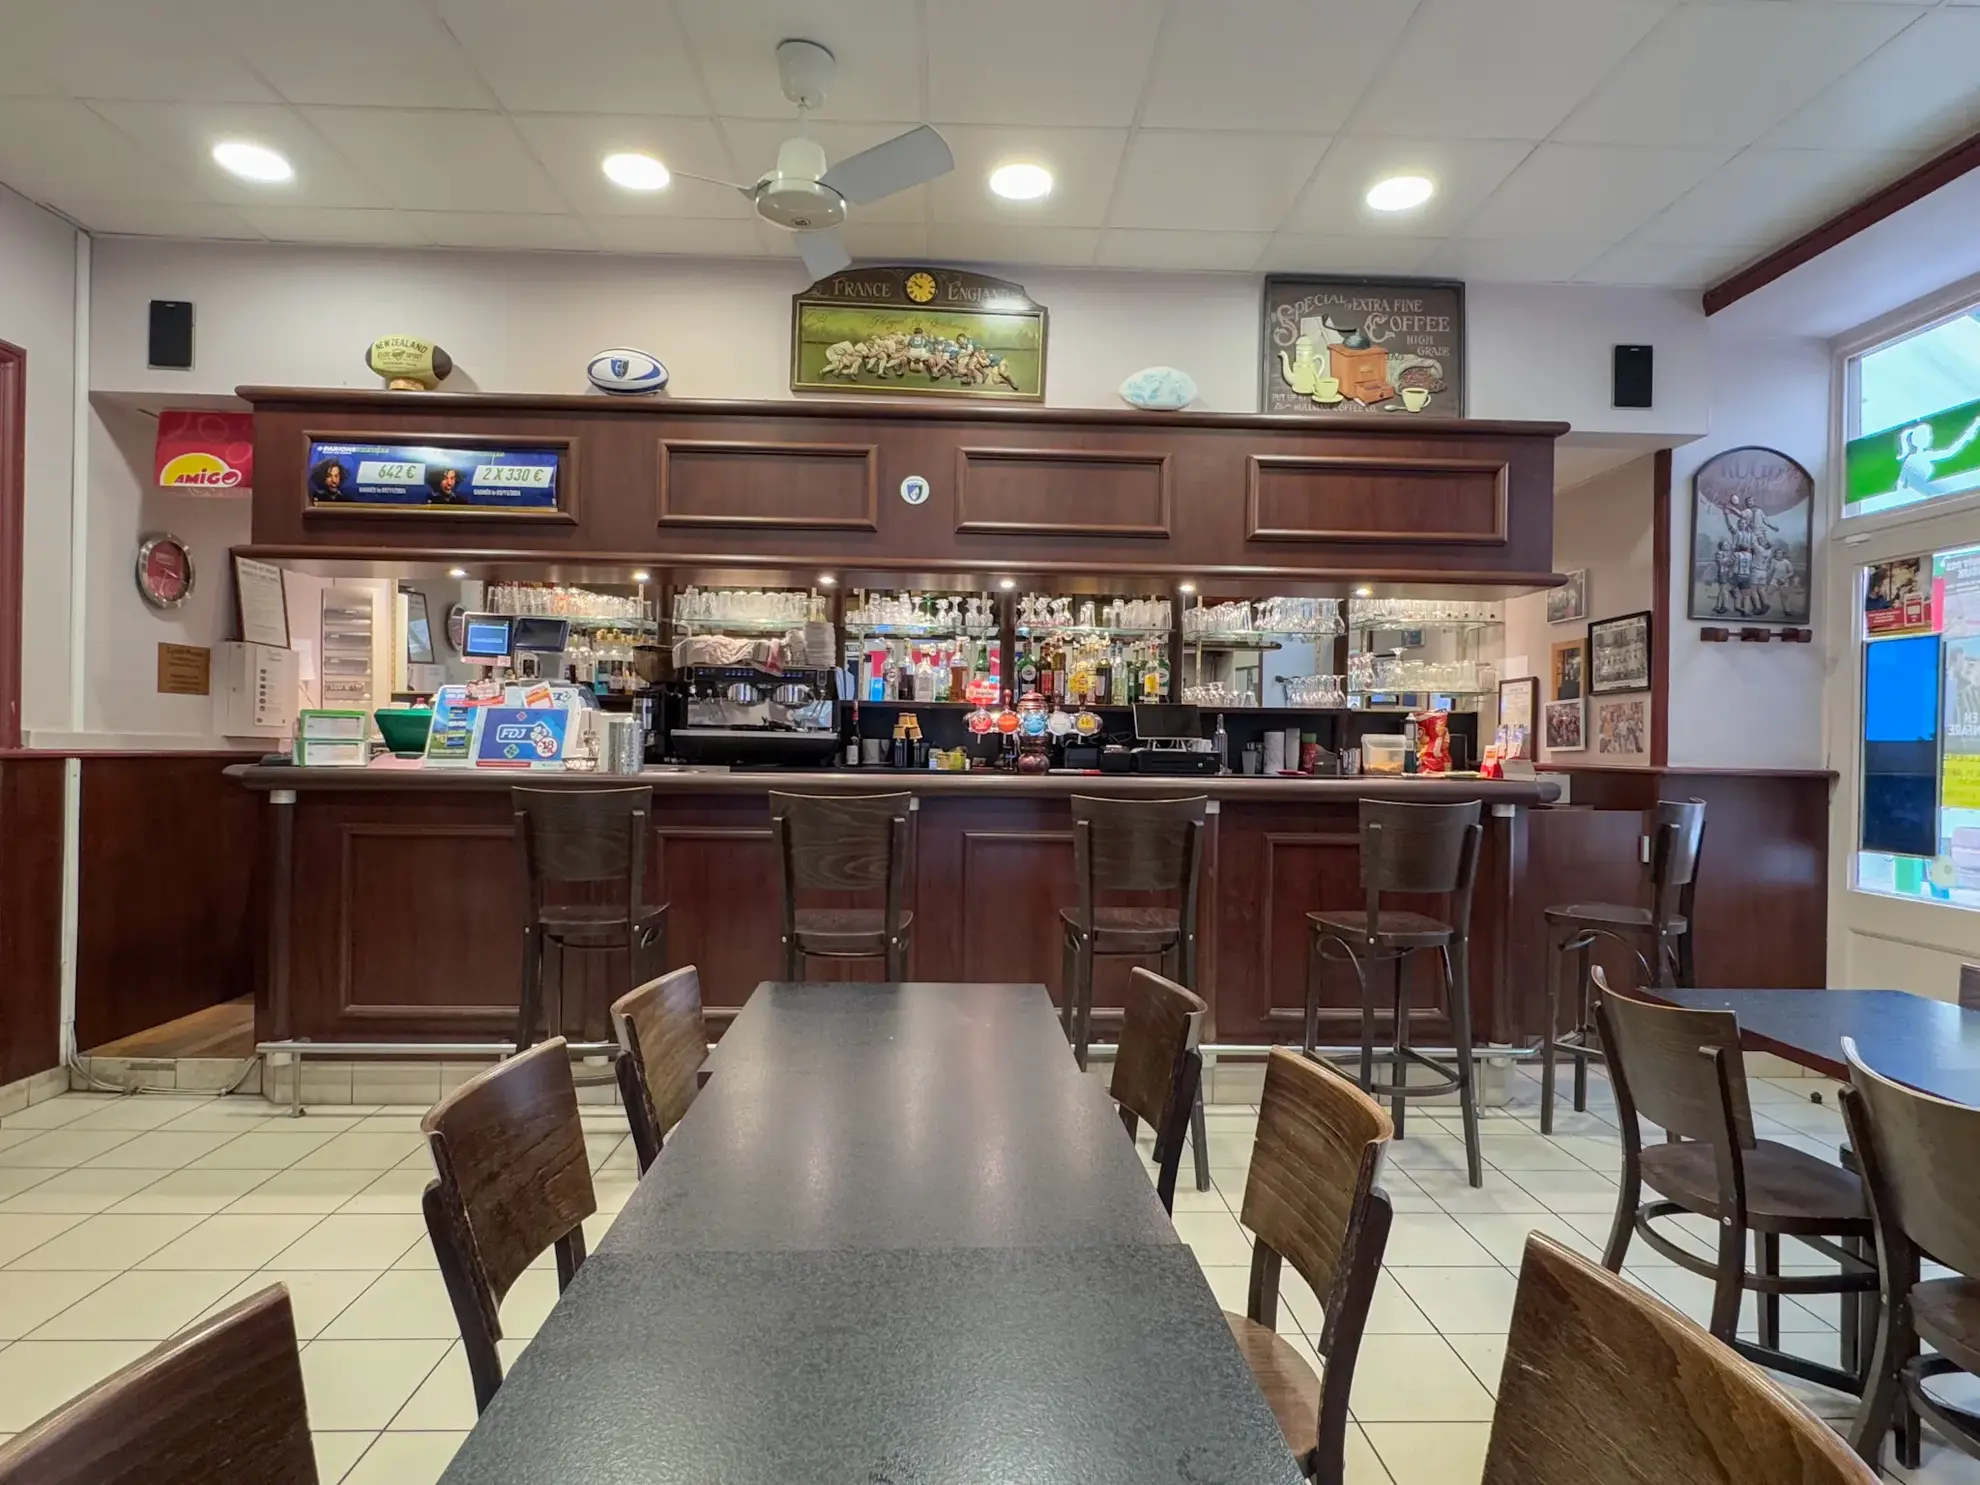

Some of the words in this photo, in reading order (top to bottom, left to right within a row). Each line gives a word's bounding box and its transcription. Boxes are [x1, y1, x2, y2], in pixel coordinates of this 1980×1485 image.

[831, 278, 891, 297] FRANCE
[1353, 298, 1390, 312] EXTRA
[1394, 299, 1424, 312] FINE
[1273, 293, 1346, 346] SPECIAL
[1364, 312, 1450, 342] COFFEE
[1406, 335, 1434, 345] HIGH
[1417, 346, 1450, 357] GRADE
[378, 464, 404, 479] 642
[406, 465, 416, 479] €
[482, 468, 492, 480] 2
[505, 468, 530, 481] 330
[533, 468, 544, 481] €
[500, 728, 527, 739] FDJ
